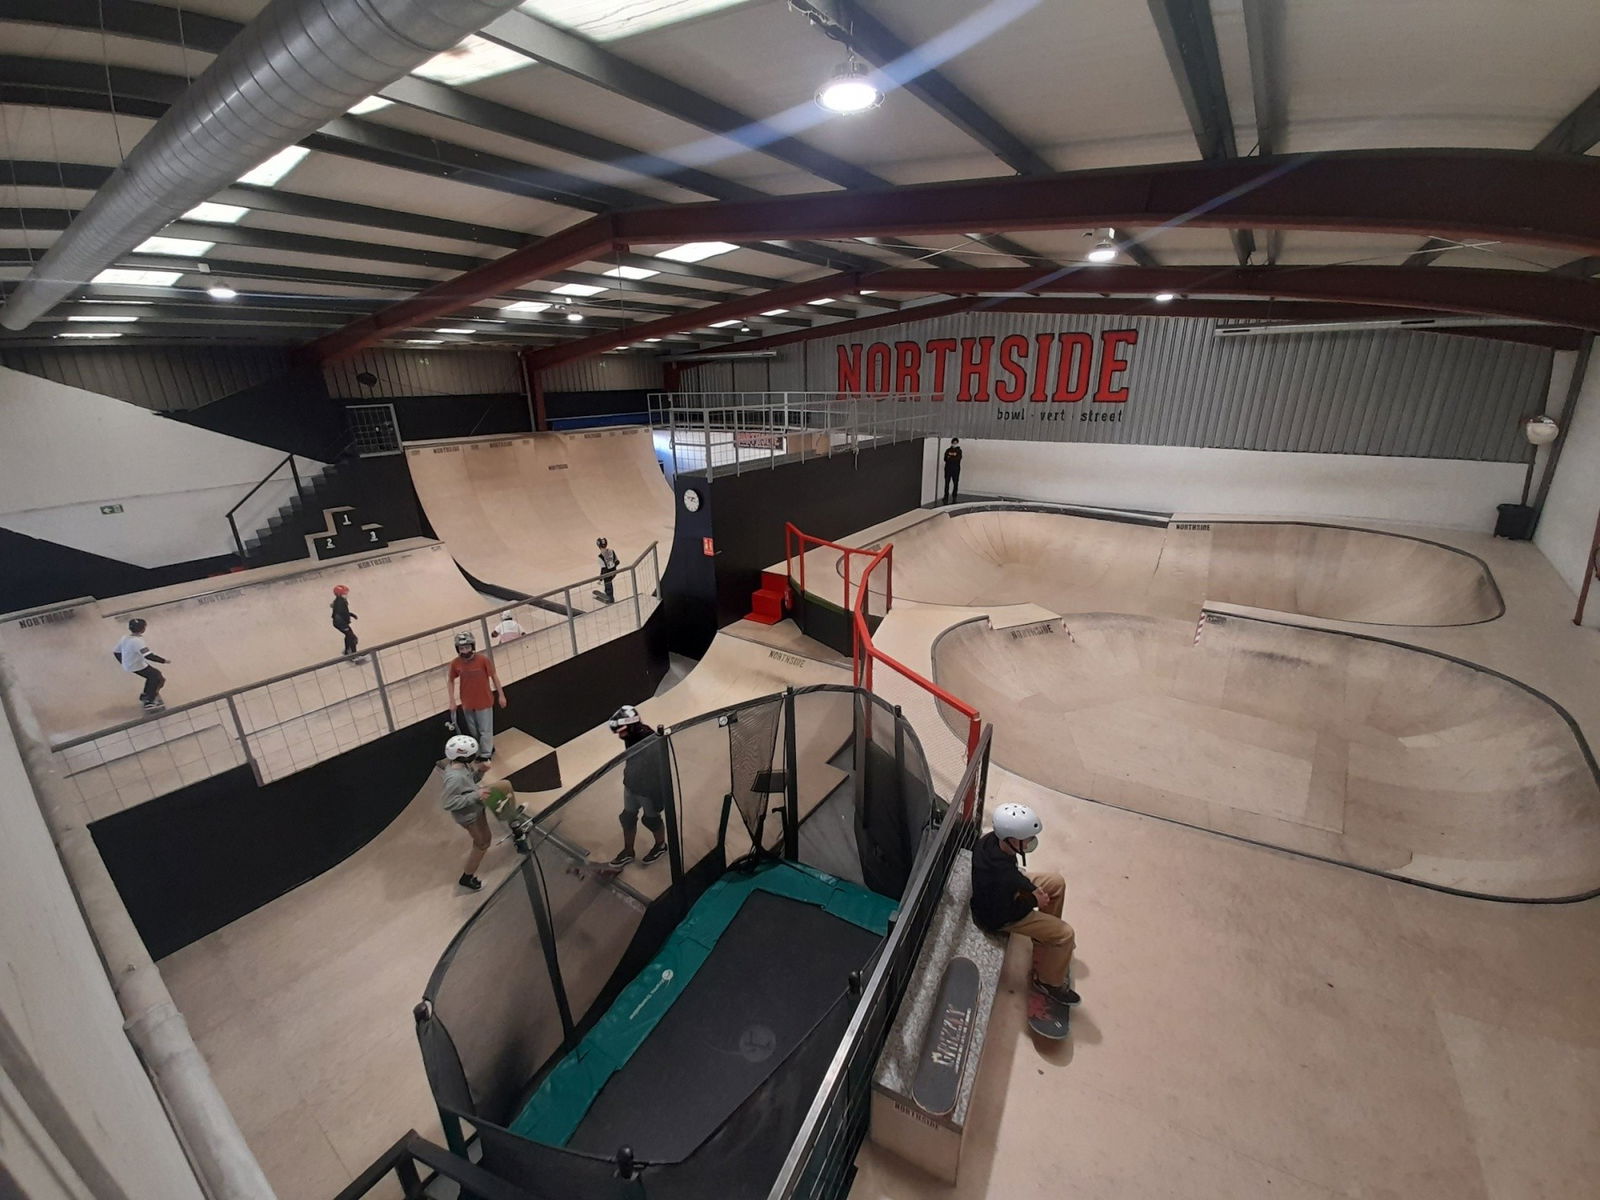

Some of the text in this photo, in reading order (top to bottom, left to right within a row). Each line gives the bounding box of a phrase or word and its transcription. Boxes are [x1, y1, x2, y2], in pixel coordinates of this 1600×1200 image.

[836, 329, 1138, 403] NORTHSIDE
[997, 408, 1122, 422] bowl vert street
[343, 514, 352, 525] 1
[370, 531, 379, 542] 3
[326, 538, 336, 549] 2
[19, 609, 76, 629] NORTHSIDE
